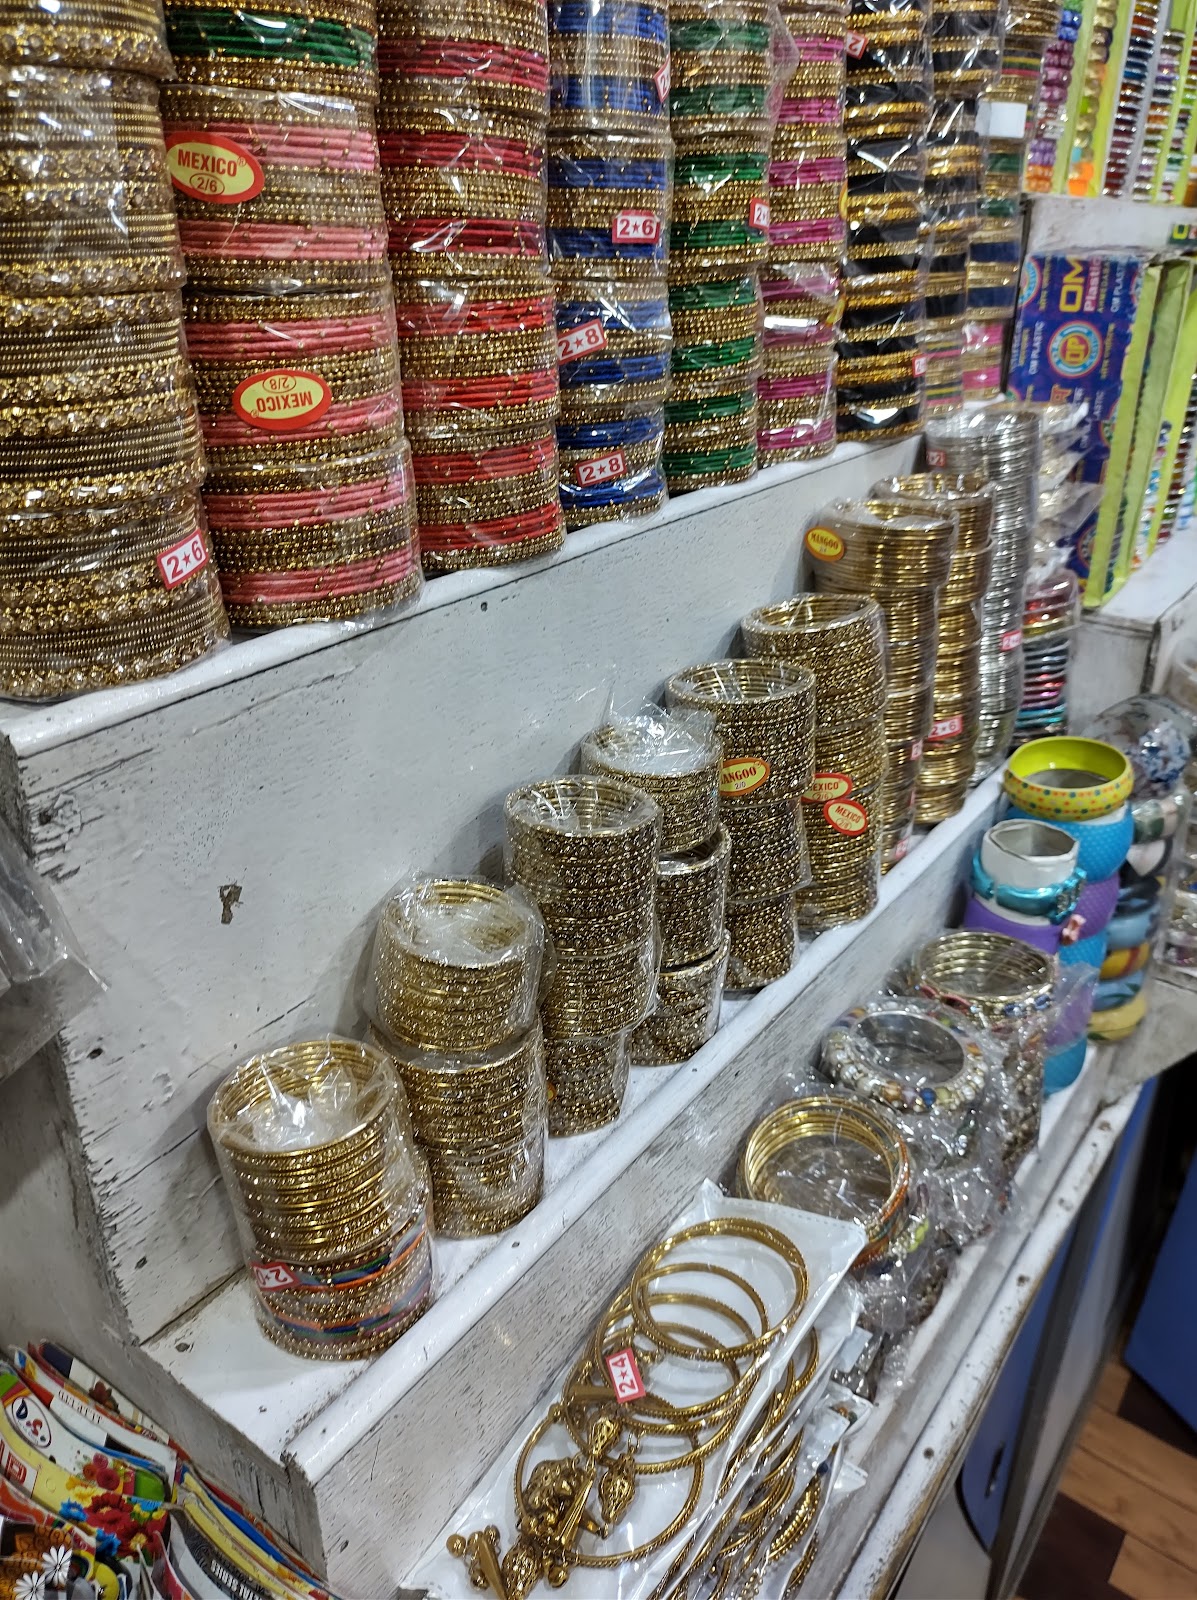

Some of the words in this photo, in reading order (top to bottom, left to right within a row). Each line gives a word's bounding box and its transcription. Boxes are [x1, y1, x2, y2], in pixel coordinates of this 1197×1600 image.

[177, 149, 238, 177] MEXICO
[196, 176, 218, 193] 2/6
[1059, 254, 1085, 312] OM
[256, 390, 313, 413] MEXICO
[811, 781, 839, 792] EXICO
